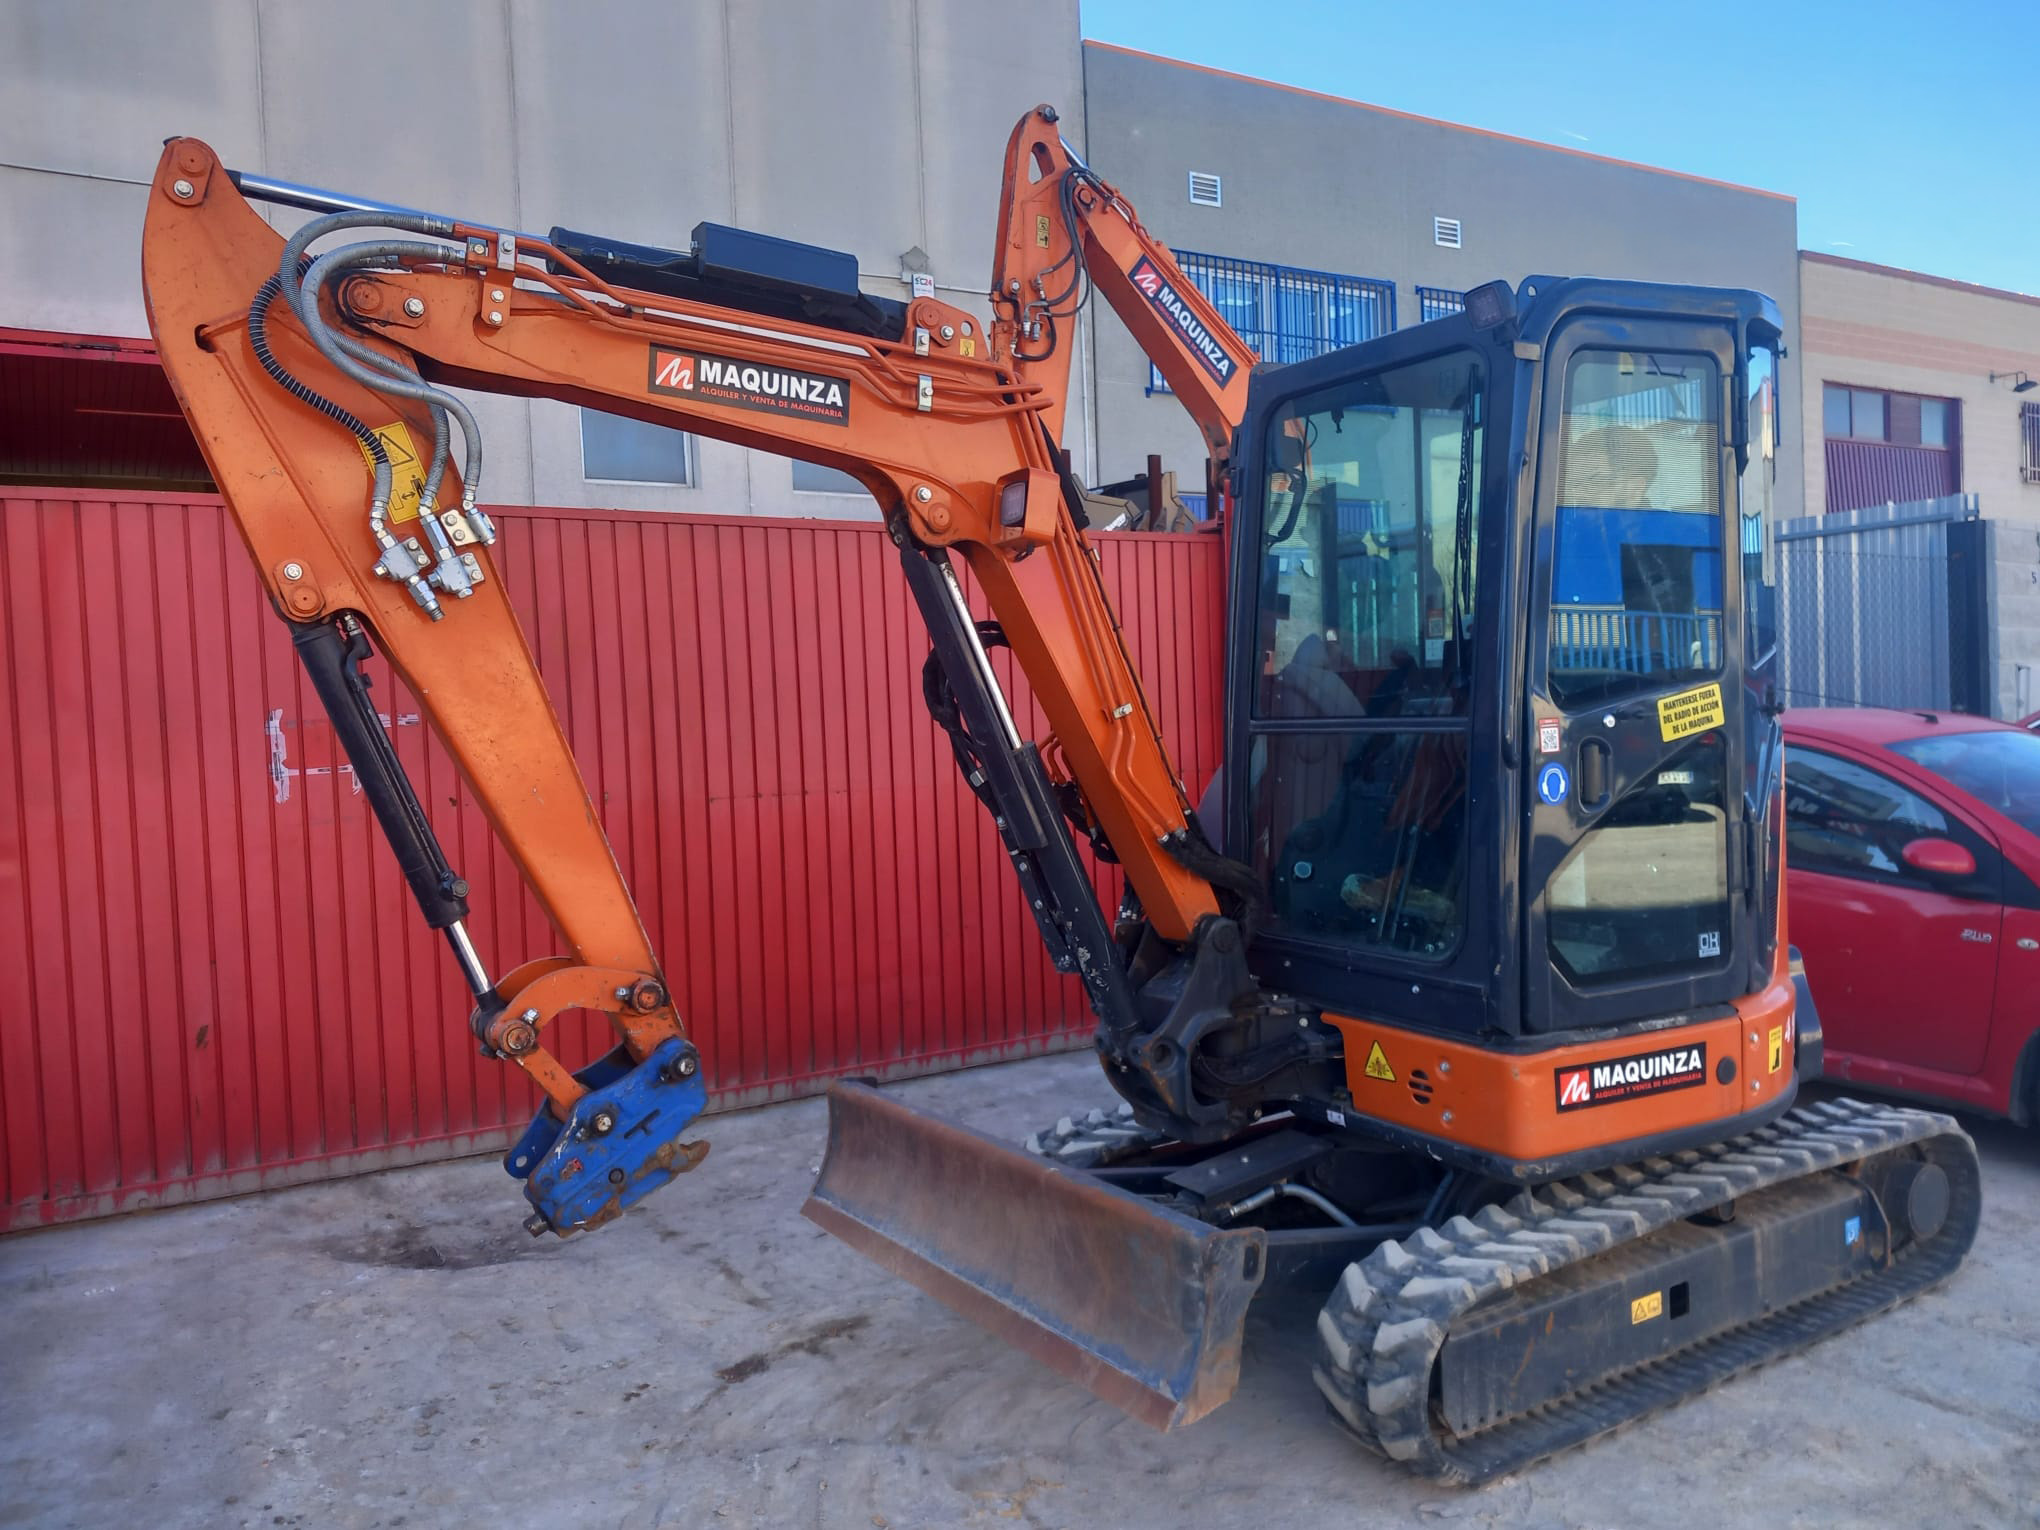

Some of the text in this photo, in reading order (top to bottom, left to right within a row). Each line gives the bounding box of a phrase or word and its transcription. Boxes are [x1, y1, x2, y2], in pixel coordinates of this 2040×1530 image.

[1159, 286, 1229, 376] MAQUINZA
[700, 359, 844, 407] MAQUINZA
[701, 386, 843, 418] ALQUILER Y VENTA DE MAQUINARIA
[1663, 689, 1716, 711] MANTENERSE FUERA
[1663, 714, 1673, 724] DEL
[1674, 708, 1692, 720] RADIO
[1692, 706, 1699, 716] DE
[1672, 724, 1680, 734] DE
[1680, 722, 1688, 732] LA
[1594, 1049, 1702, 1089] MAQUINZA
